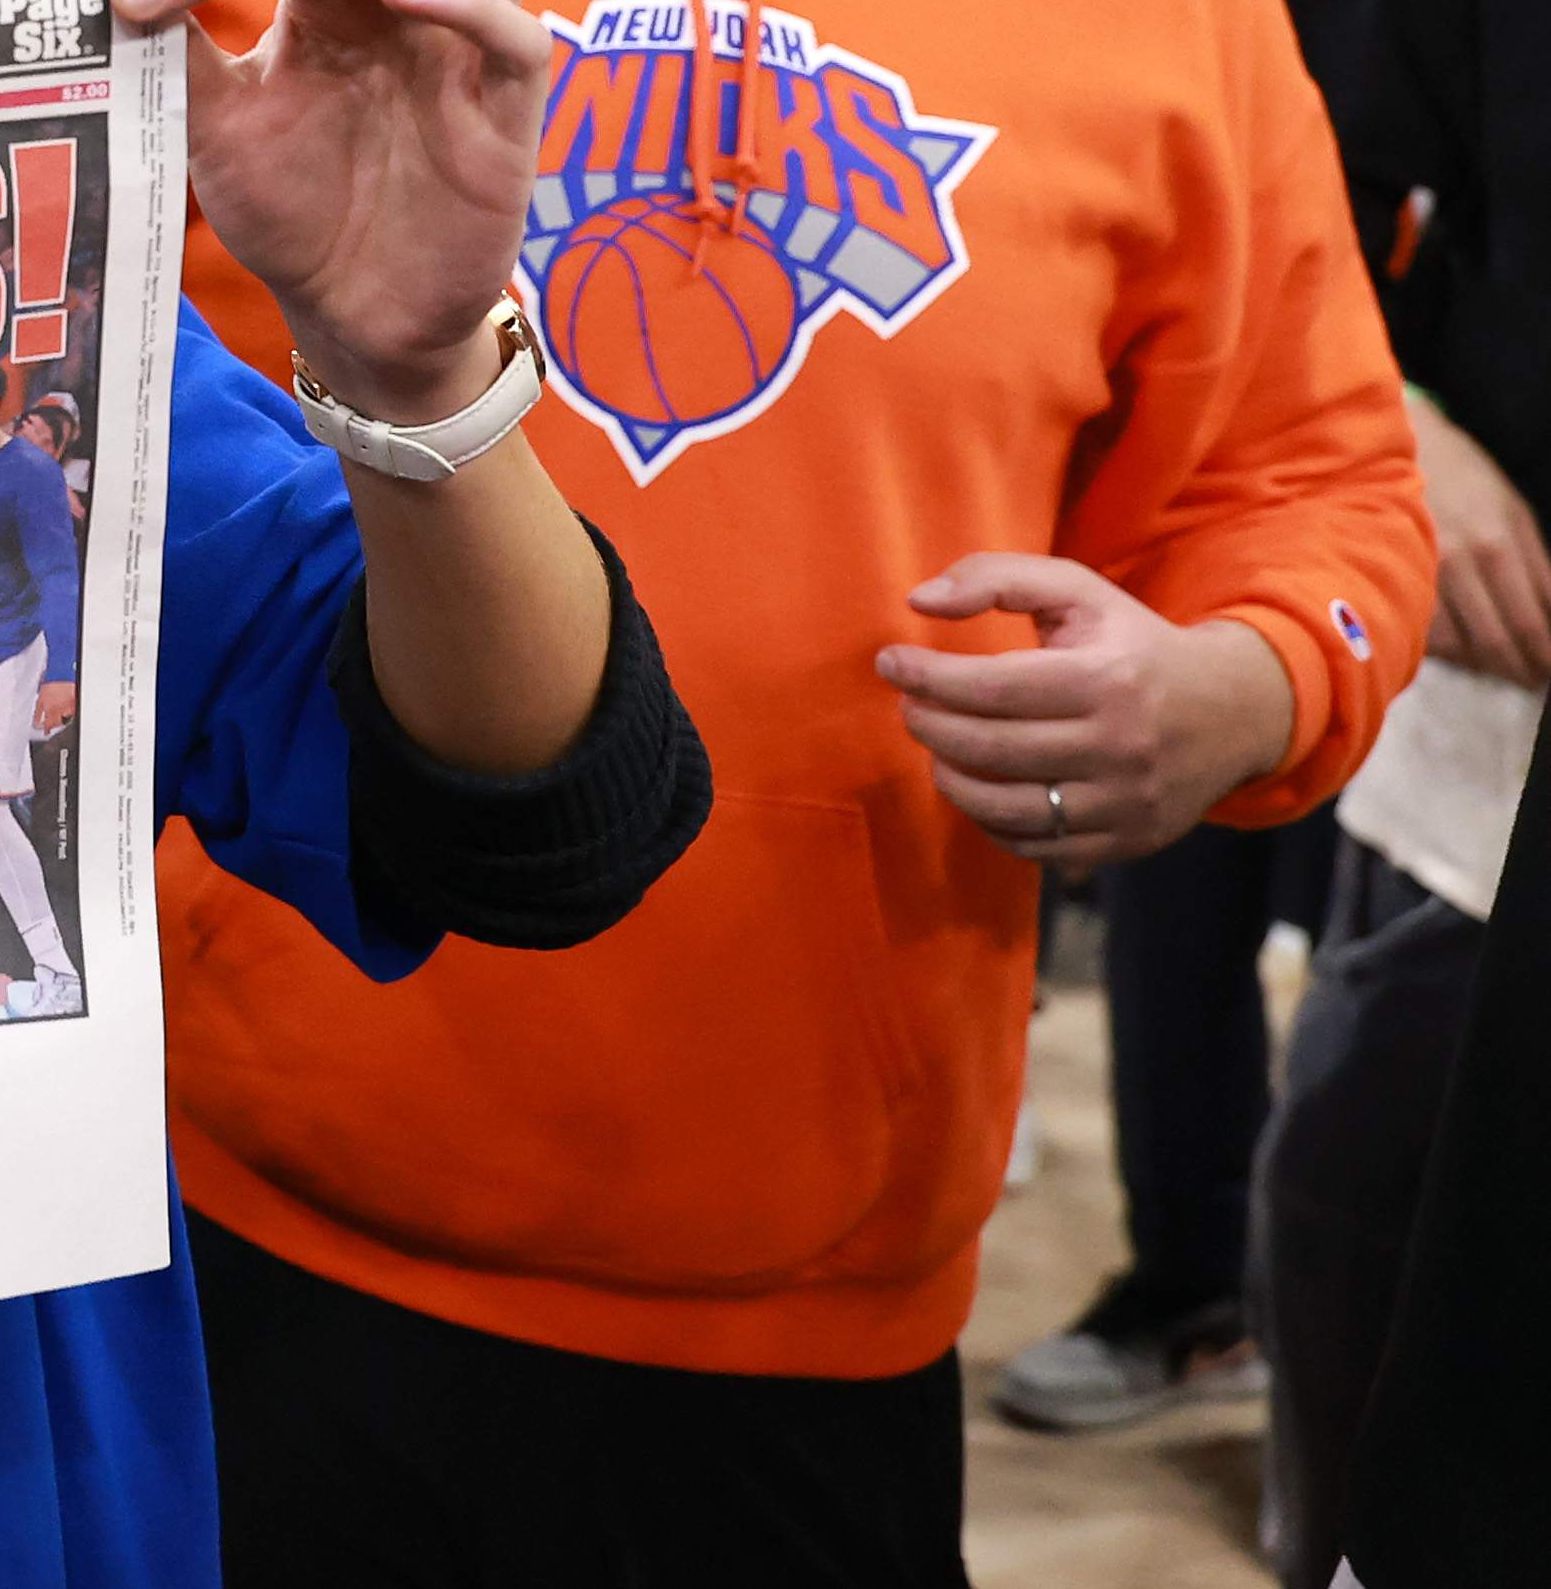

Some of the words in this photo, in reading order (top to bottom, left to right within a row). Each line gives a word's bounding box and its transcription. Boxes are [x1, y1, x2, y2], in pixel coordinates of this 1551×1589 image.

[590, 6, 686, 46] NEW
[61, 82, 109, 101] $2.00
[537, 41, 954, 271] NICKS
